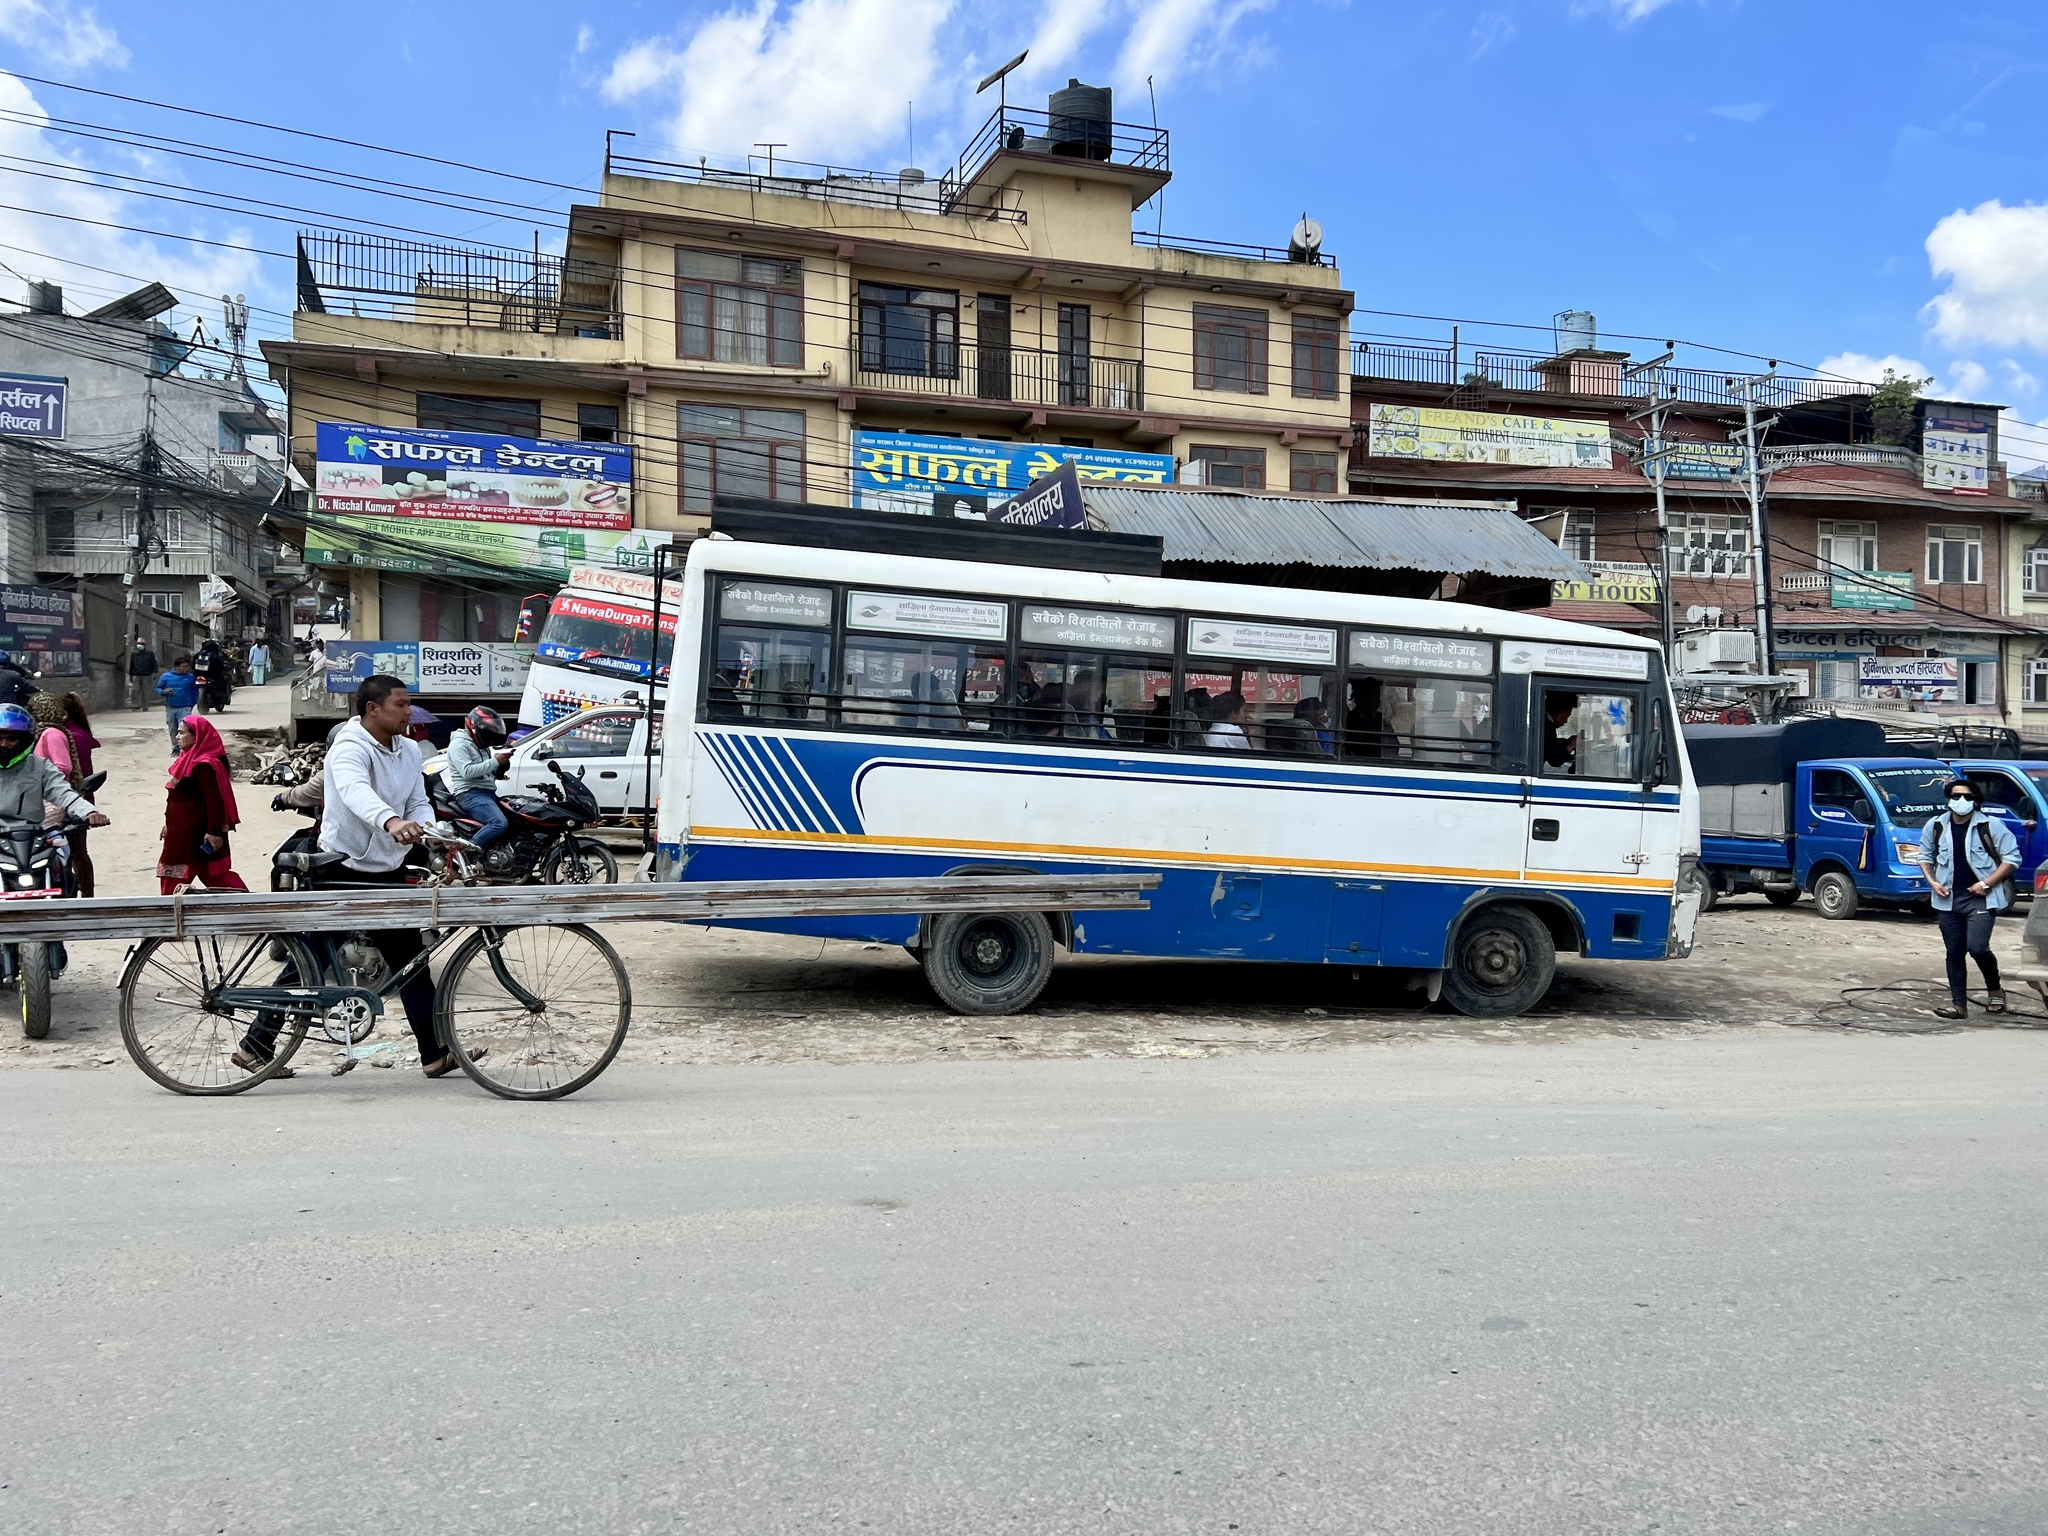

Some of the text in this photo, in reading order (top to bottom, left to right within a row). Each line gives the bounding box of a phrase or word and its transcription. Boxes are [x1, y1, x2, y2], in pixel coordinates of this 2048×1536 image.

[0, 411, 42, 431] स्पिटल
[1425, 410, 1553, 430] FREAND'S CAFE &
[1512, 431, 1537, 446] GUEST
[1538, 433, 1565, 447] HOUSE
[368, 438, 484, 465] सफल
[496, 444, 606, 473] डेन्टल
[1666, 442, 1743, 456] FIENDS CAFE &
[861, 447, 1011, 490] सफल
[318, 498, 395, 513] Dr. Nischal Kunwar
[381, 523, 415, 536] MOBILE
[417, 527, 435, 537] APP
[615, 546, 662, 567] शिव
[596, 571, 682, 599] पशुपतीाथ
[1600, 571, 1632, 585] CAFE
[727, 588, 752, 600] सबैको
[571, 602, 677, 631] NawaDurgaTrns
[929, 613, 971, 623] Development
[988, 608, 1000, 617] लि.
[1032, 610, 1065, 625] सबैको
[1068, 612, 1122, 630] विश्वासिलो
[1152, 637, 1164, 648] लि.
[1359, 636, 1390, 650] सबैको
[1393, 637, 1445, 654] विश्वासिलो
[422, 647, 483, 661] शिवशक्ति
[555, 647, 576, 660] Shr
[422, 663, 483, 676] हार्डवेयर्स
[869, 665, 900, 679] Berger
[1472, 660, 1484, 671] लि.
